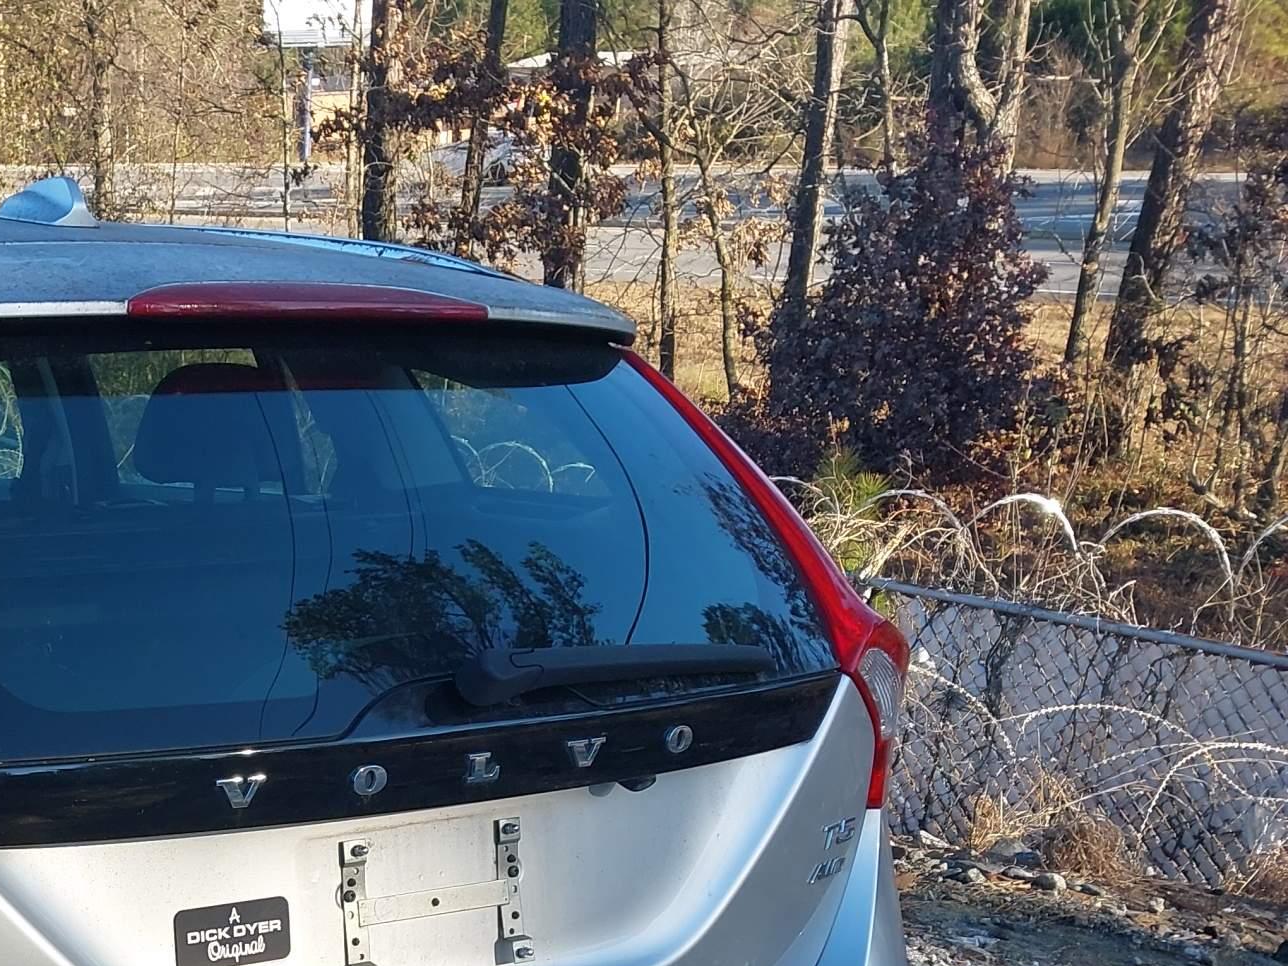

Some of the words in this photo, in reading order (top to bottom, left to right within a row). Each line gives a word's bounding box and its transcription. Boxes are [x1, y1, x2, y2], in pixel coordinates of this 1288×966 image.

[216, 723, 694, 809] VOLVO
[822, 816, 856, 850] T5
[228, 906, 241, 924] A
[186, 926, 231, 945] DICK
[232, 918, 282, 938] DYER
[207, 934, 266, 963] Original
